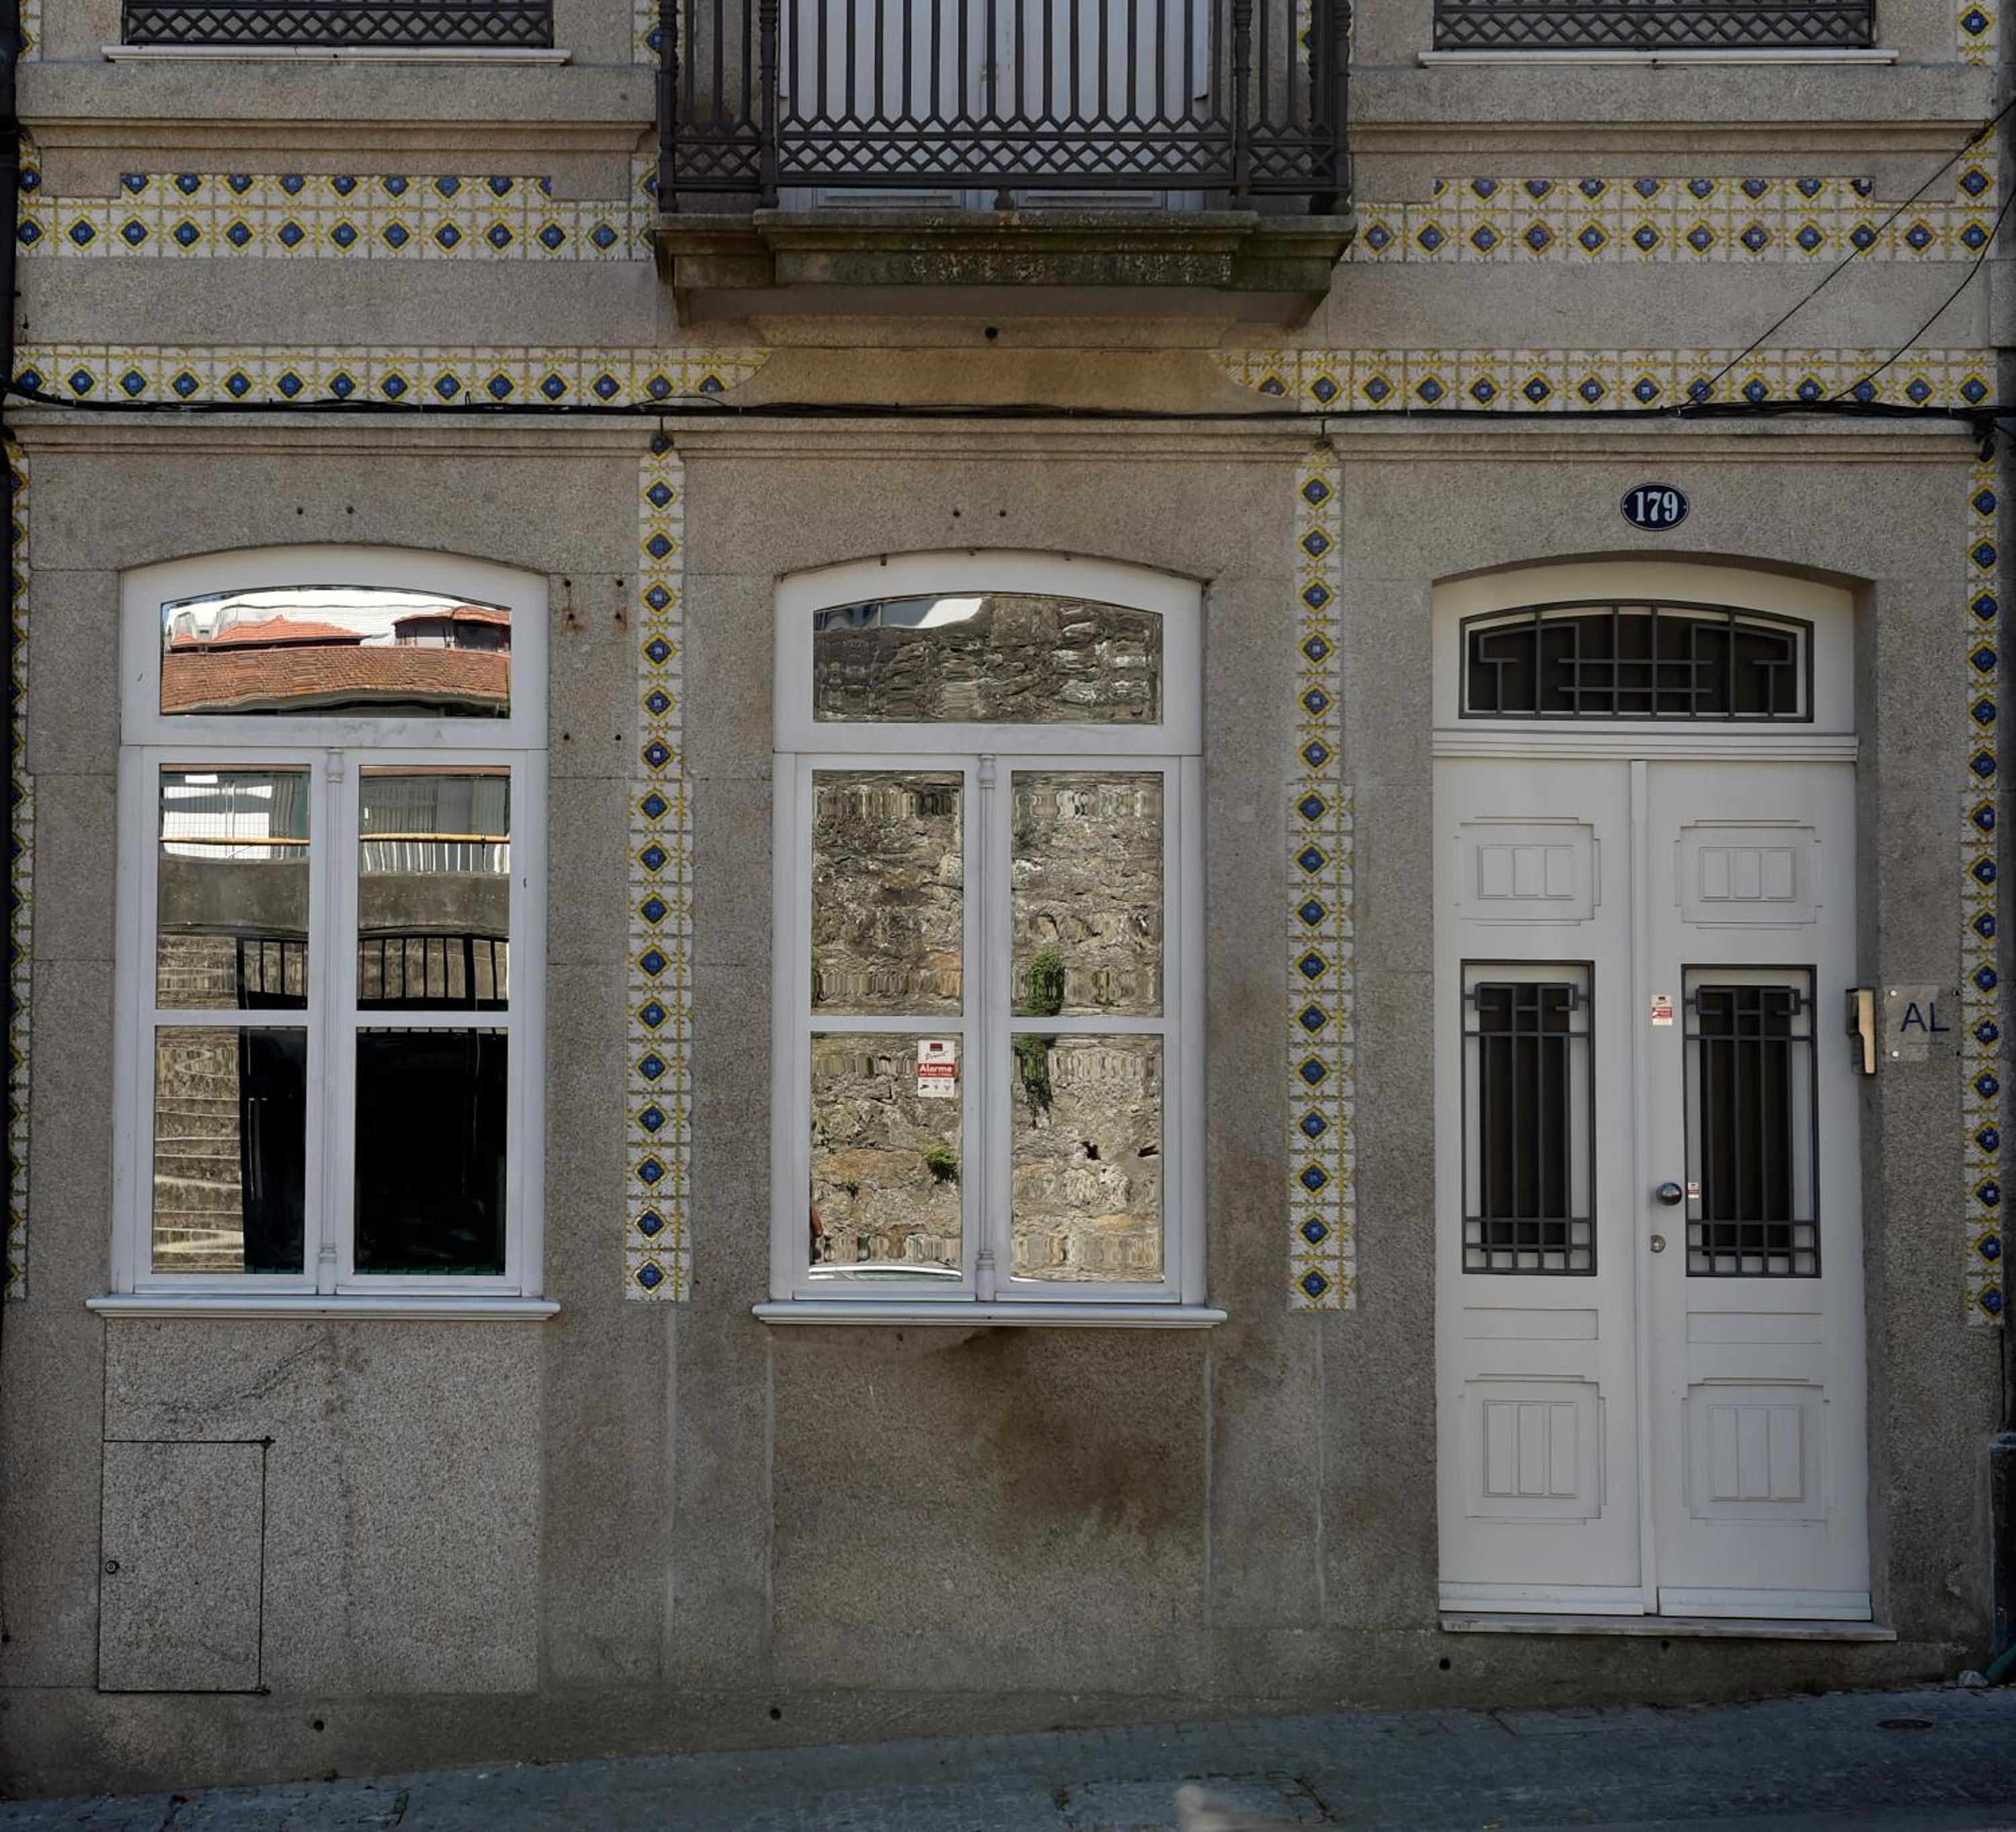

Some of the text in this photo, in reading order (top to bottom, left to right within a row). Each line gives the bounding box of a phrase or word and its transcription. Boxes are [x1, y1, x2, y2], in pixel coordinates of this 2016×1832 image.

[1636, 491, 1678, 522] 179
[1900, 1002, 1949, 1032] AL
[919, 1064, 952, 1073] Alarme
